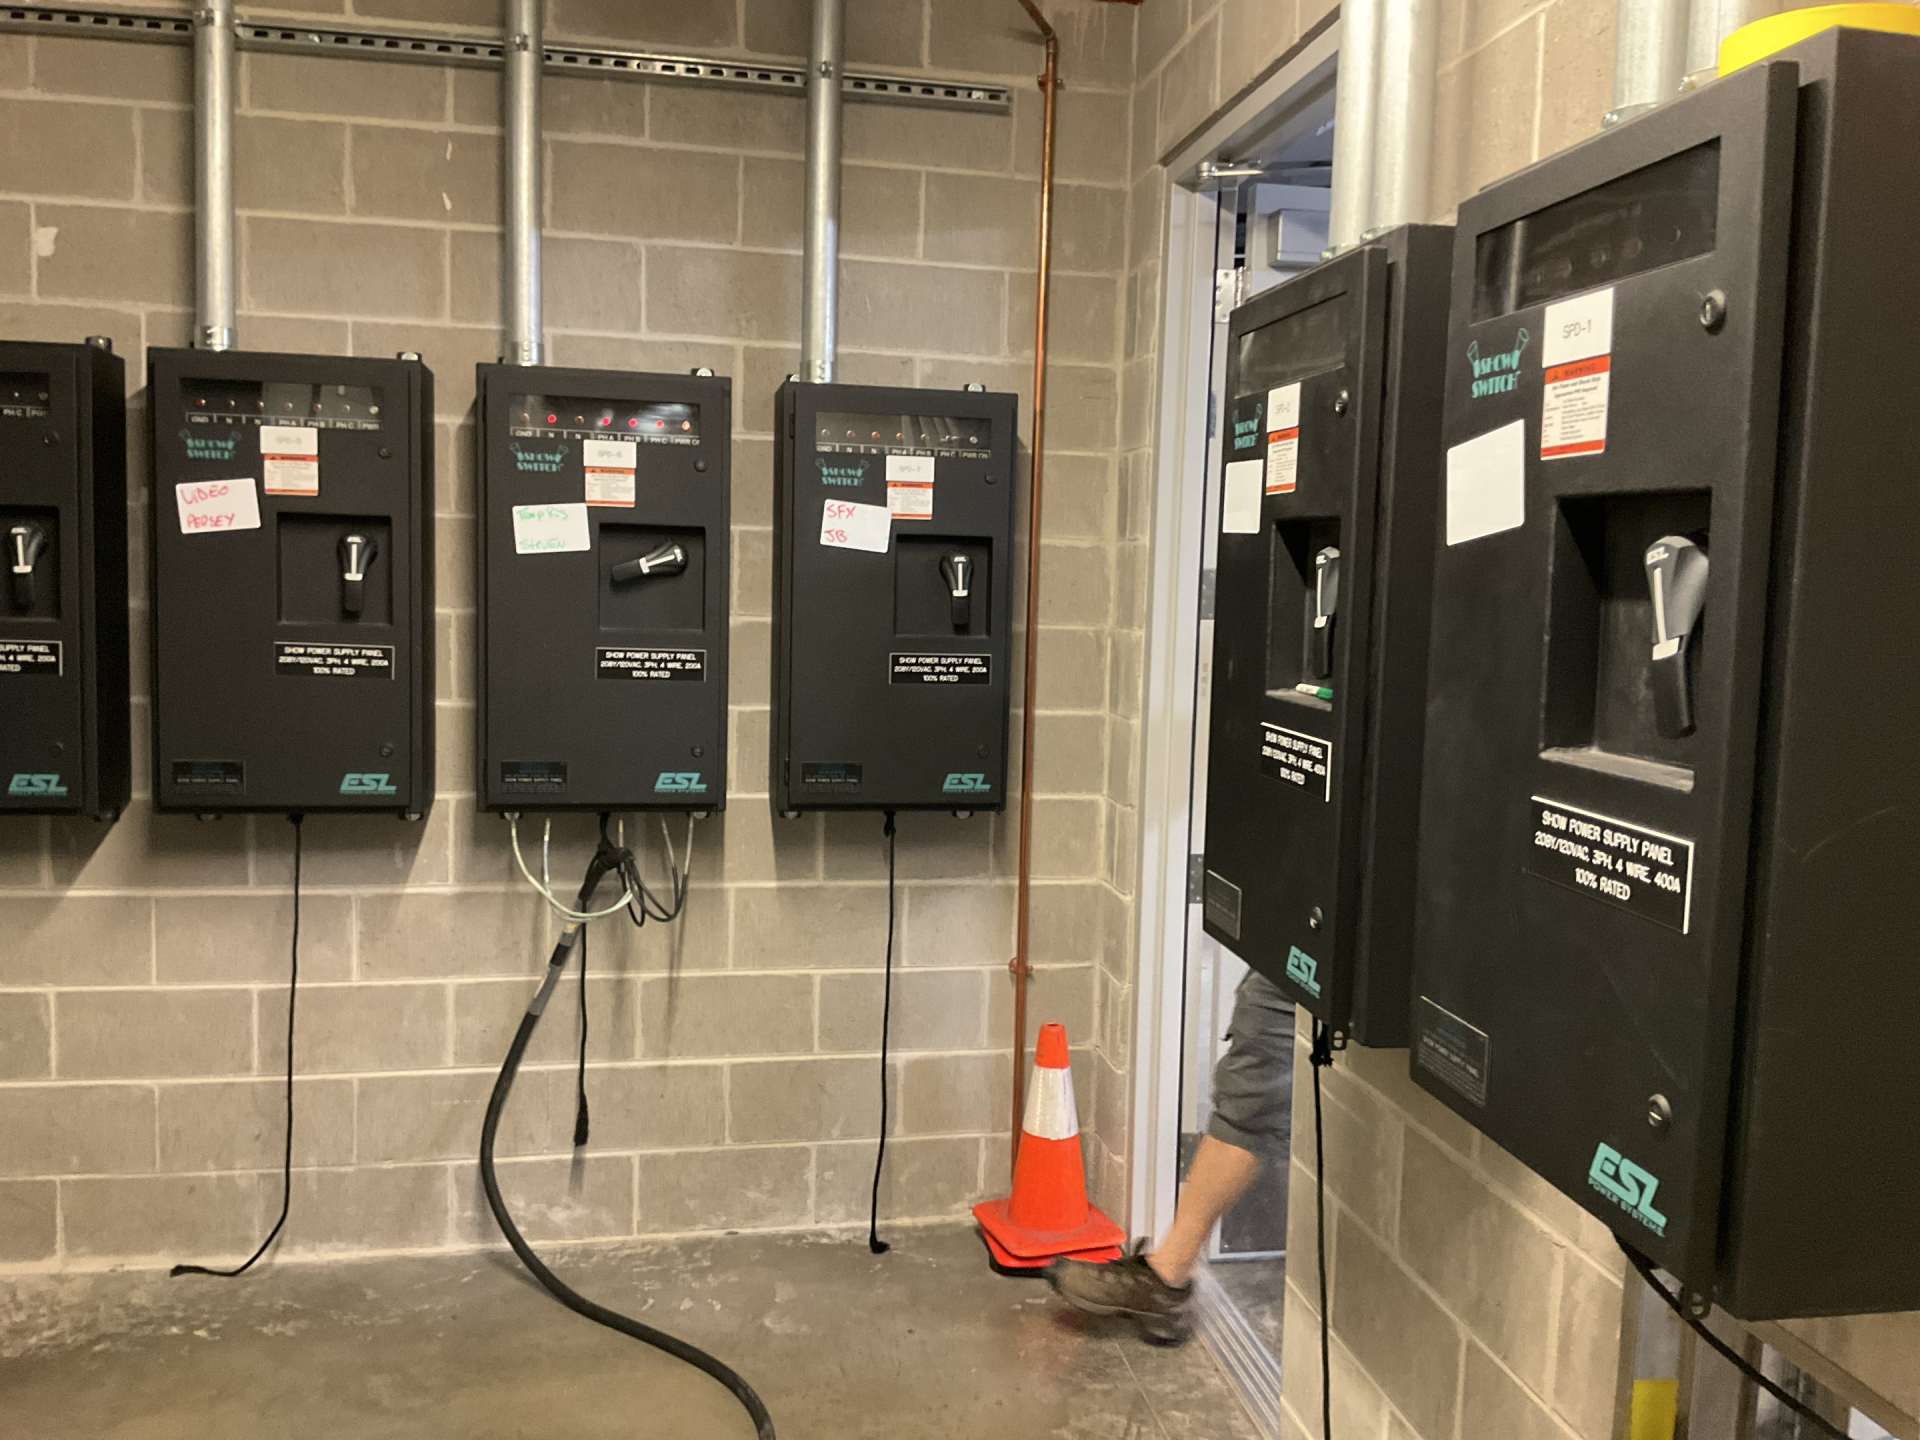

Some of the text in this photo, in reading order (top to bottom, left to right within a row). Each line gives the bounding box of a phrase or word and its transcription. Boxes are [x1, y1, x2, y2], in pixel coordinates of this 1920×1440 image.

[1562, 318, 1592, 339] SPD-1
[515, 430, 532, 438] GND
[826, 504, 856, 519] SFX
[824, 529, 848, 543] JB
[306, 647, 332, 655] POWER
[334, 648, 360, 656] SUPPLY
[605, 651, 624, 659] SHOW
[650, 652, 675, 660] SUPPLY
[676, 653, 696, 661] PANEL
[684, 662, 702, 670] 200A
[940, 657, 962, 665] SUPPLY
[332, 667, 356, 676] RATED
[632, 670, 671, 678] 100% RATED
[8, 773, 68, 791] ESL
[340, 773, 398, 791] ESL
[654, 772, 707, 789] ESL
[943, 773, 991, 789] ESL
[1542, 810, 1674, 867] SHOW POWER SUPPLY PANEL
[1575, 867, 1631, 901] 100% RATED
[1615, 858, 1624, 873] 4
[1654, 872, 1681, 894] 400A
[1286, 945, 1321, 993] ESL
[1588, 1142, 1667, 1229] ESL
